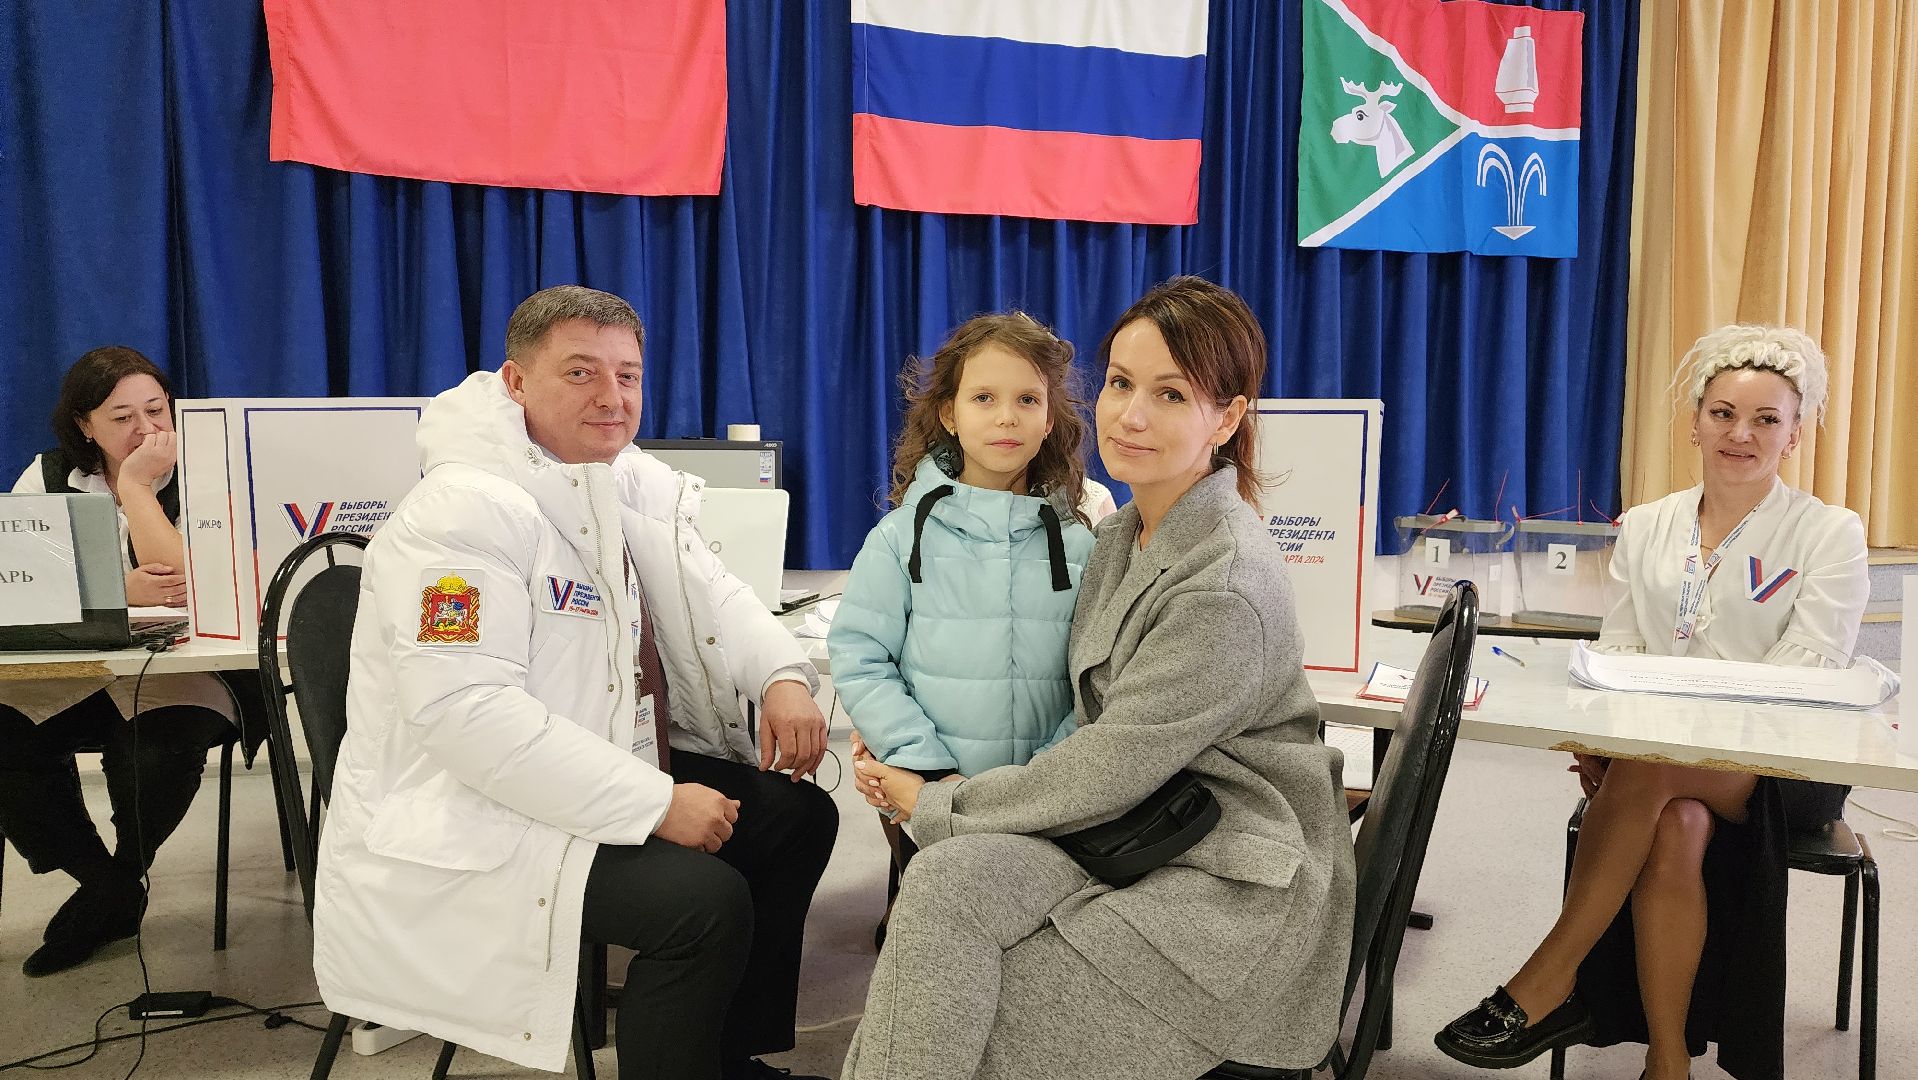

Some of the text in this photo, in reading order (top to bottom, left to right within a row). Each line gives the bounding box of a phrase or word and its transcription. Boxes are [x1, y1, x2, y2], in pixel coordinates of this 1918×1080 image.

[339, 500, 388, 511] ВЫБОРЫ
[334, 511, 395, 522] ПРЕЗИДЕН
[1269, 515, 1322, 527] ВЫБОРЫ
[0, 519, 50, 533] ТЕЛЬ
[330, 523, 374, 533] РОССИИ
[1275, 541, 1304, 552] СИИ
[1303, 555, 1325, 564] 2024
[1432, 545, 1441, 563] 1
[1554, 551, 1568, 570] 2
